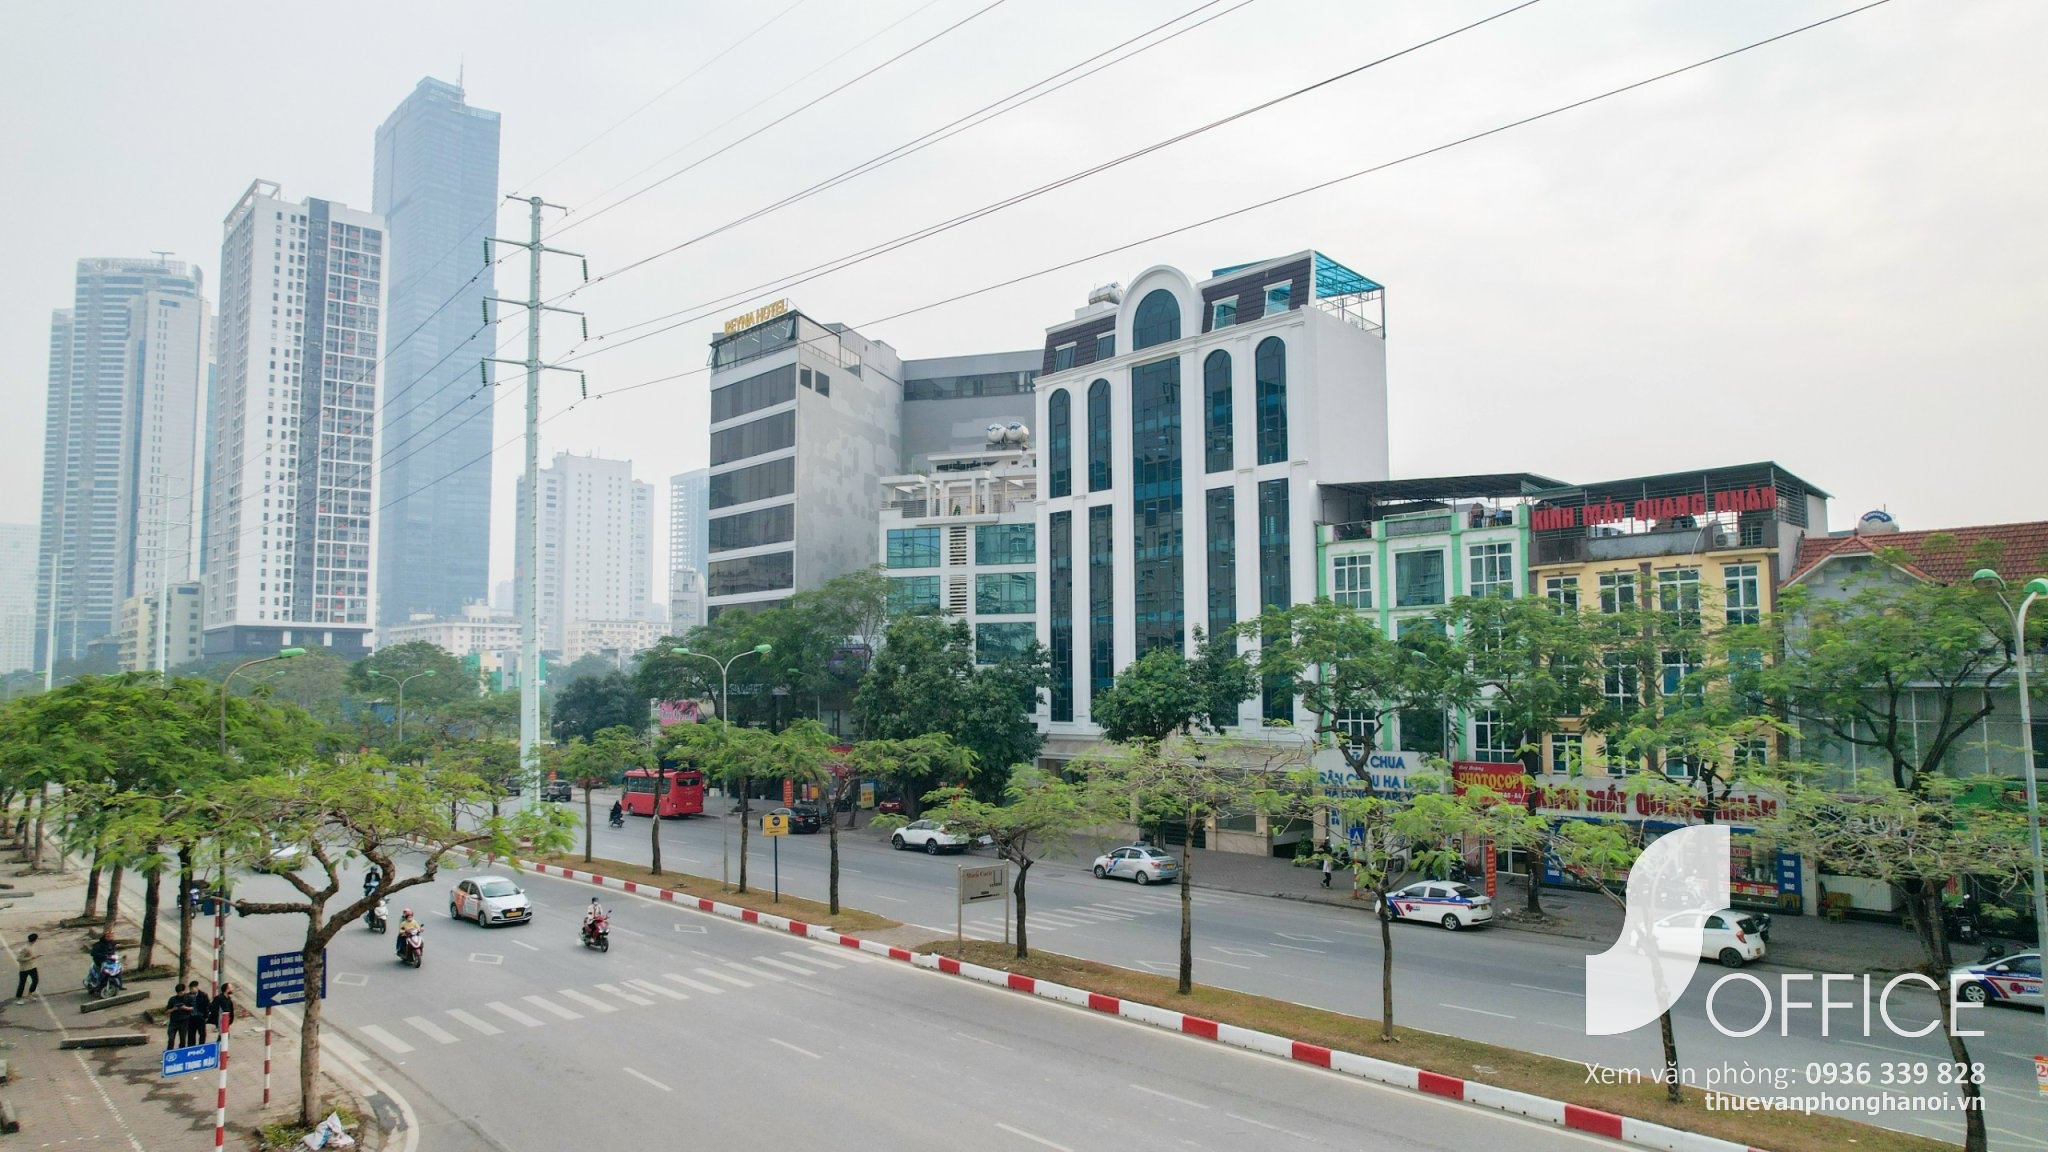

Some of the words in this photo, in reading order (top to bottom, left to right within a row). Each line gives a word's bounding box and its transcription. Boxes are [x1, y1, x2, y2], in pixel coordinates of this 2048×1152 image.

[756, 298, 788, 322] HOTEL
[1634, 493, 1705, 521] QUANG
[1370, 755, 1406, 769] CHUA
[1459, 772, 1521, 789] PHOTOCOP
